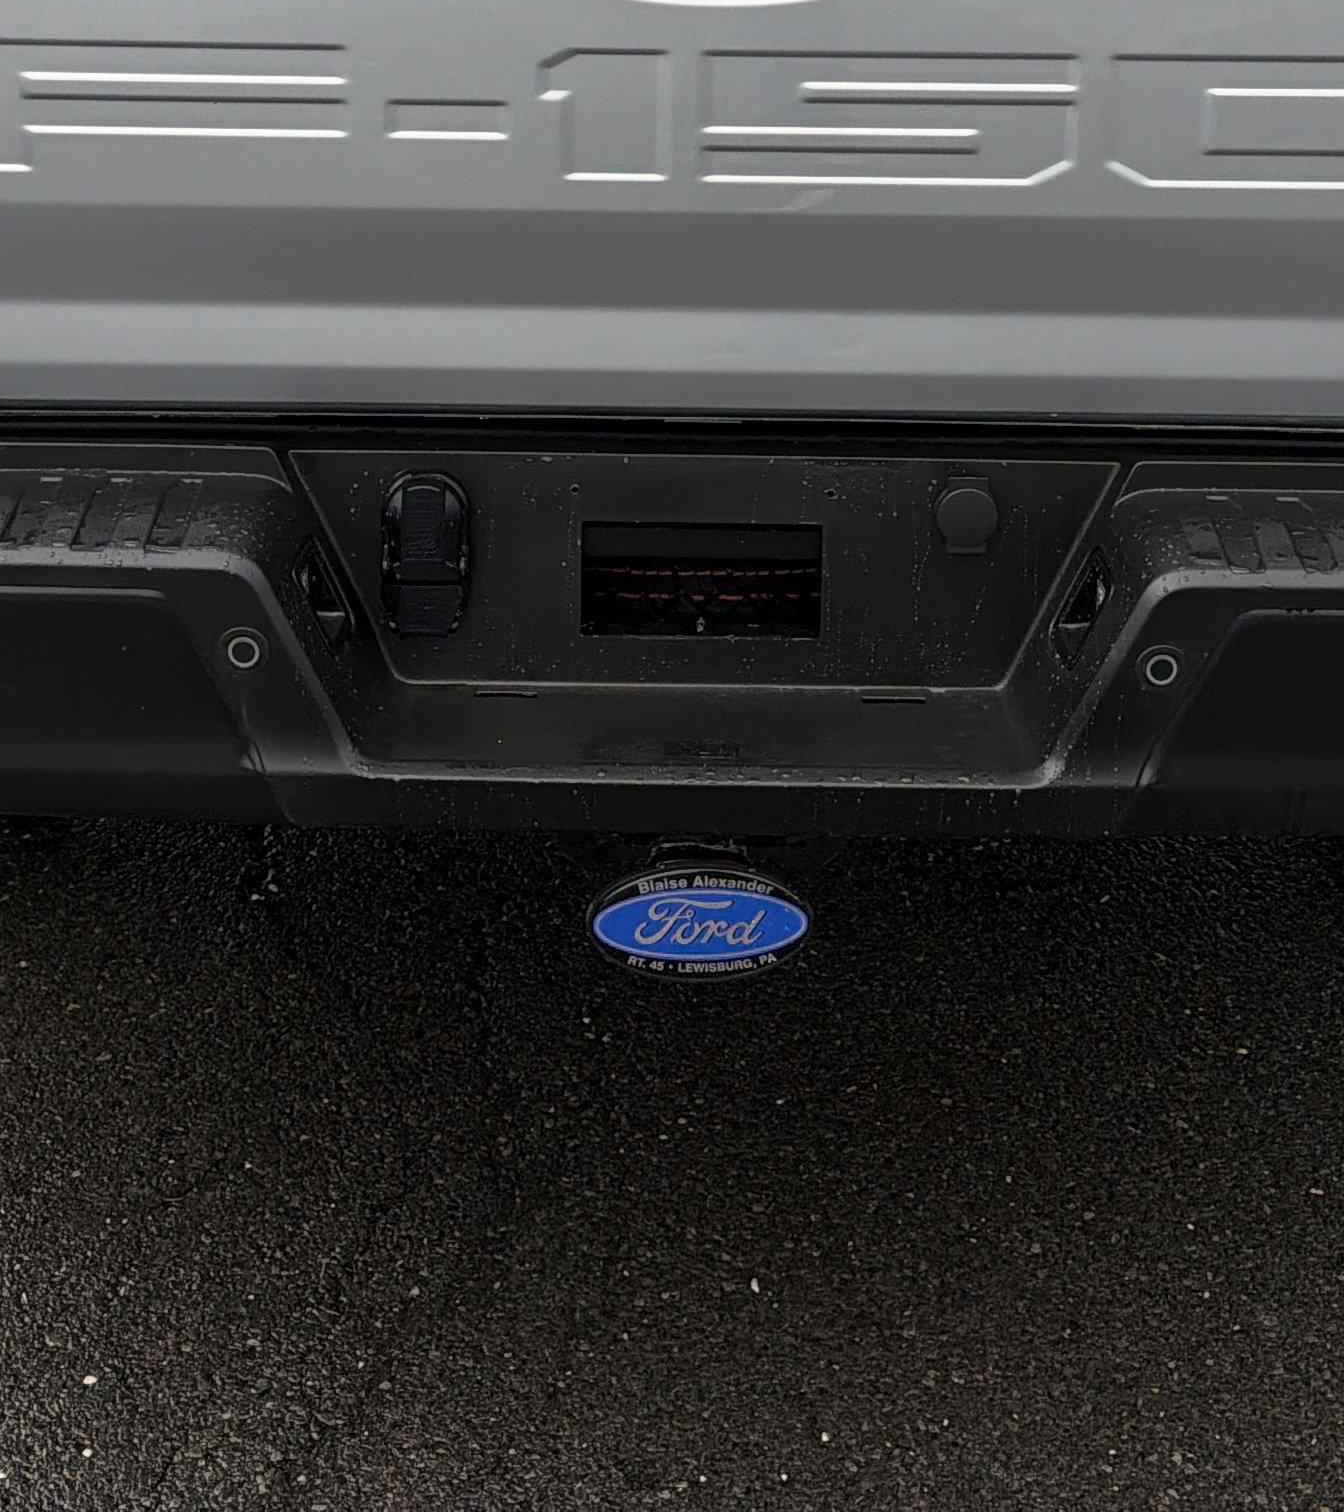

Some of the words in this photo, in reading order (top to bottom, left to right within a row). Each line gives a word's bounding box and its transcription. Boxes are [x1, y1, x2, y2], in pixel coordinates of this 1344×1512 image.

[637, 877, 688, 895] Blaise
[692, 875, 775, 895] Alexander
[634, 898, 766, 945] Ford
[627, 956, 646, 969] RT.
[649, 961, 665, 971] 45
[678, 958, 757, 974] LEWISBURG,
[759, 953, 778, 966] PA
